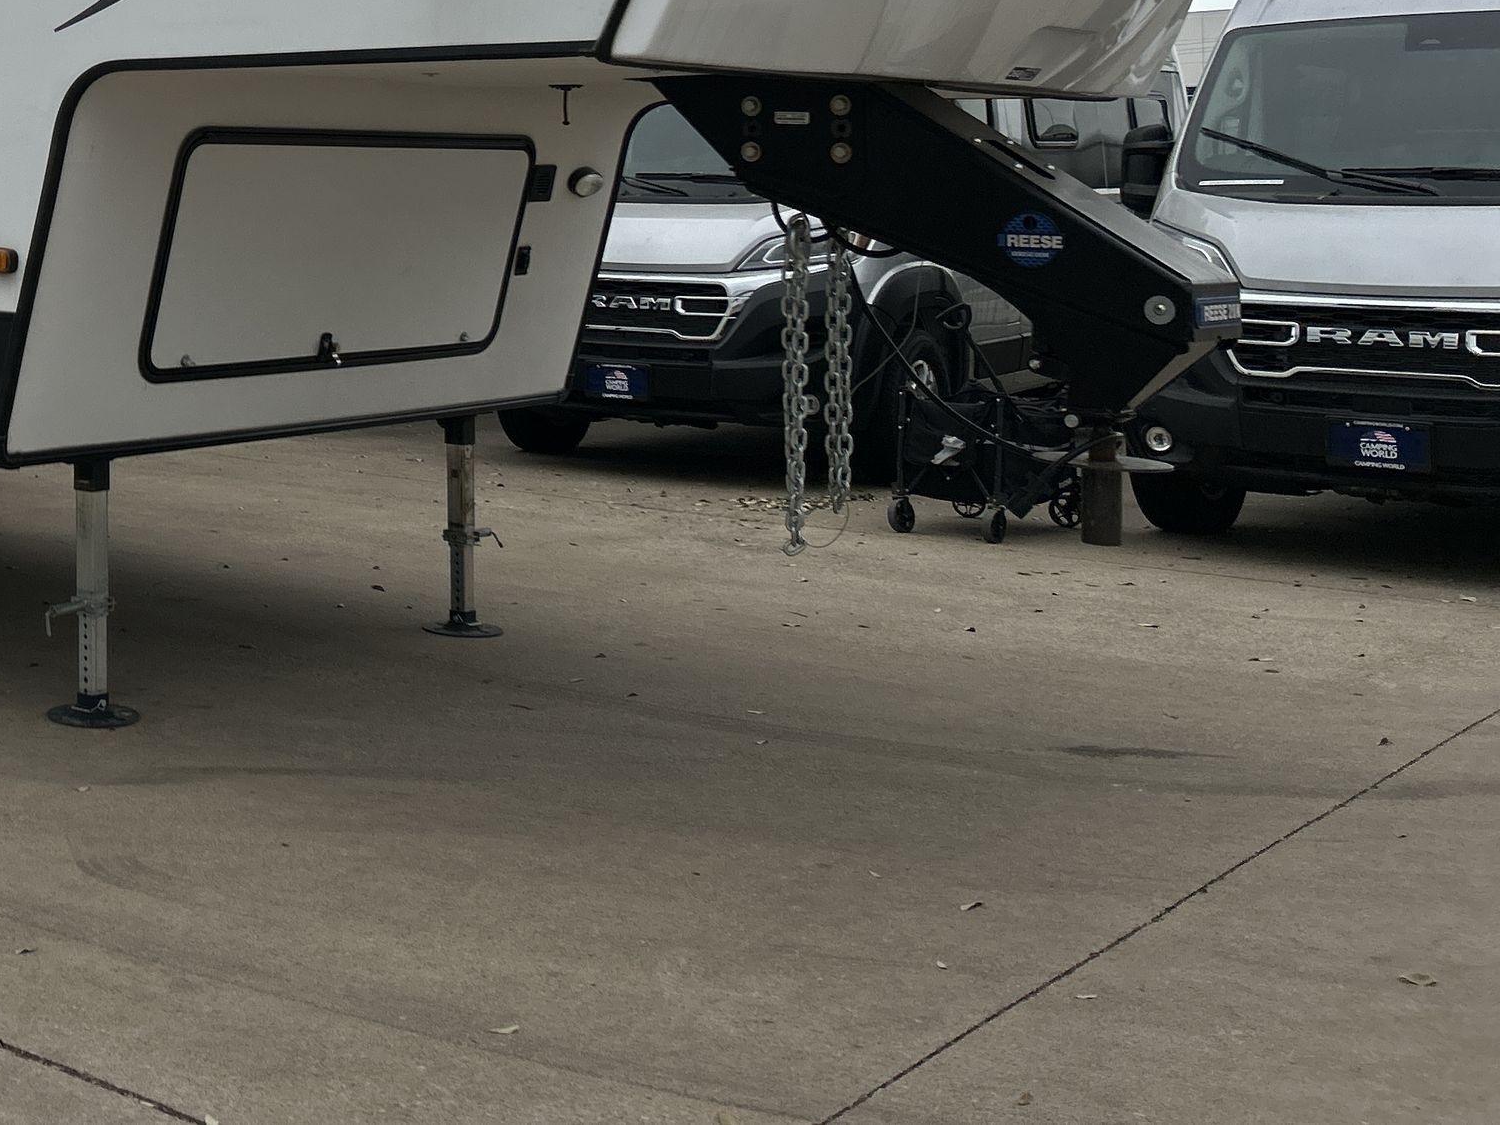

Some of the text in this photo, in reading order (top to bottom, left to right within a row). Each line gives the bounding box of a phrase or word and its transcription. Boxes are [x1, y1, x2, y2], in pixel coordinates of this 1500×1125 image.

[1006, 234, 1064, 250] REESE
[1306, 326, 1460, 350] RAM
[1359, 442, 1398, 452] CAMPING
[1360, 448, 1398, 459] WORLD
